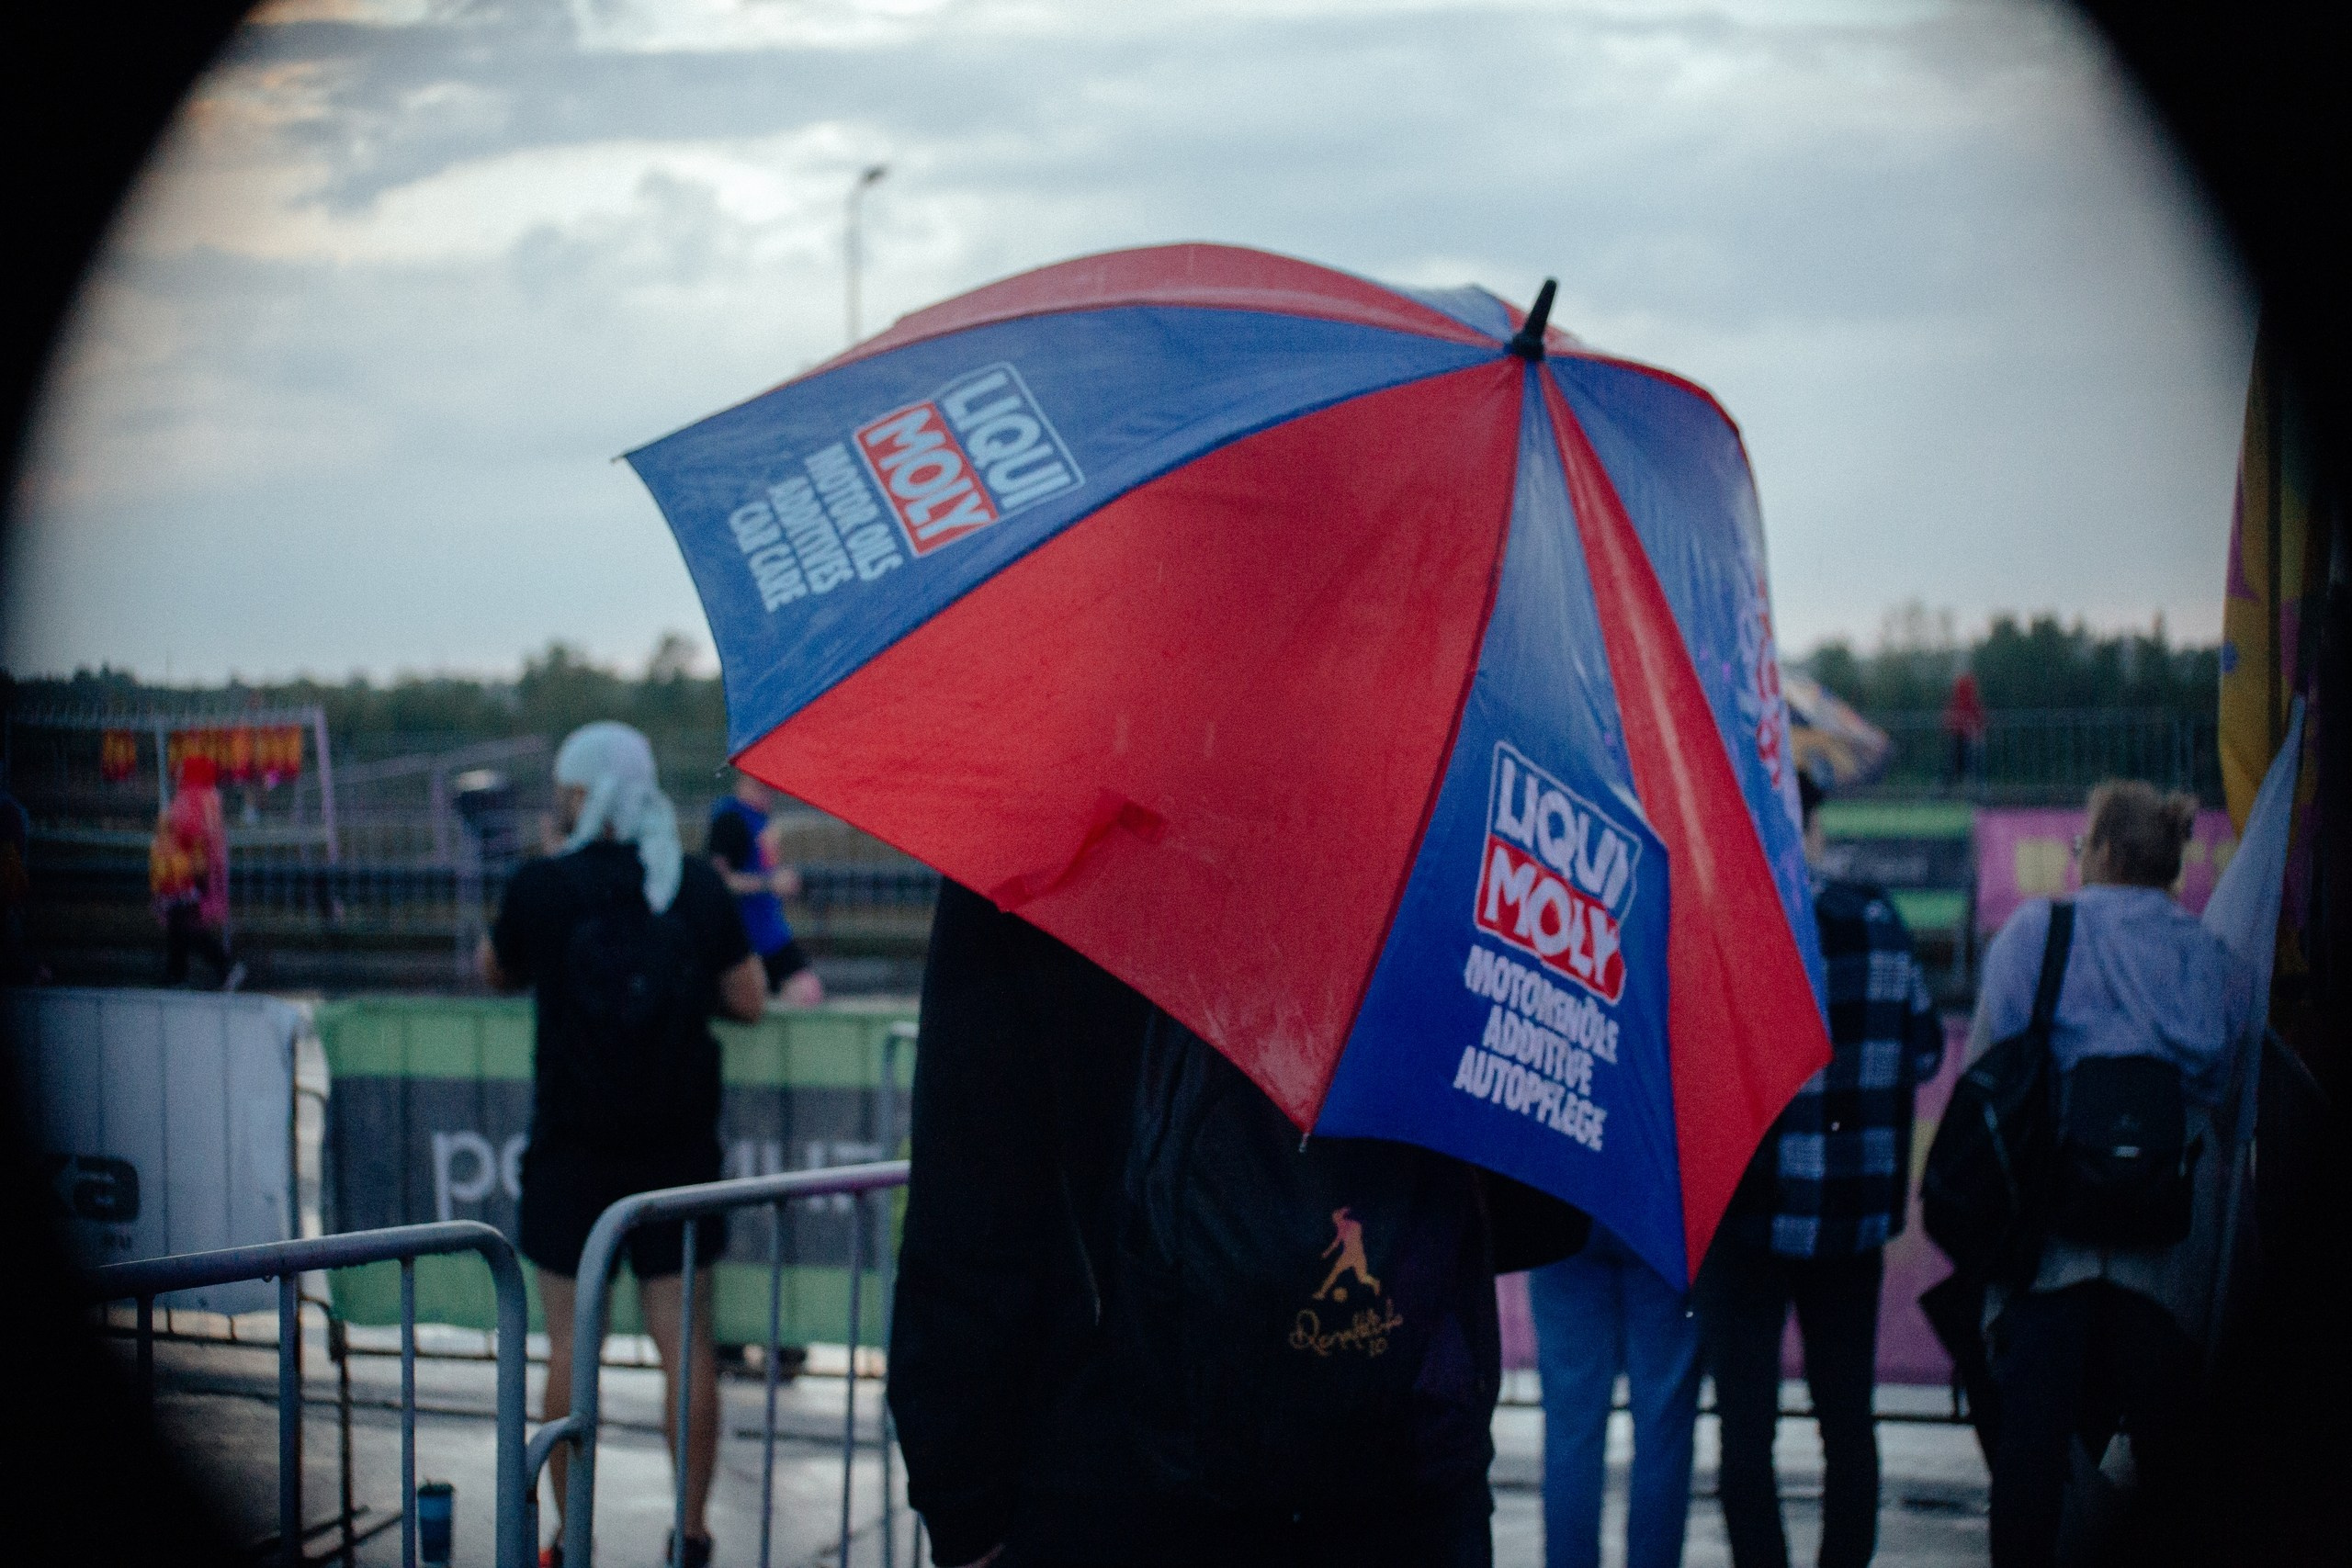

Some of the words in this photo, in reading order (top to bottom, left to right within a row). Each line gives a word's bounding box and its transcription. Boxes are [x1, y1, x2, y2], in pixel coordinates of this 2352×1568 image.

[865, 407, 991, 540] MOLY
[942, 371, 1071, 510] LIQUI
[729, 501, 782, 554] CAR
[749, 543, 808, 613] CARE
[767, 476, 854, 594] ADDITIVES
[804, 442, 880, 535] MOTOR
[845, 523, 904, 581] OILS
[1496, 757, 1630, 908] LIQUI
[1484, 849, 1621, 985] MOLY
[1453, 1045, 1608, 1152] AUTOPFLEGE
